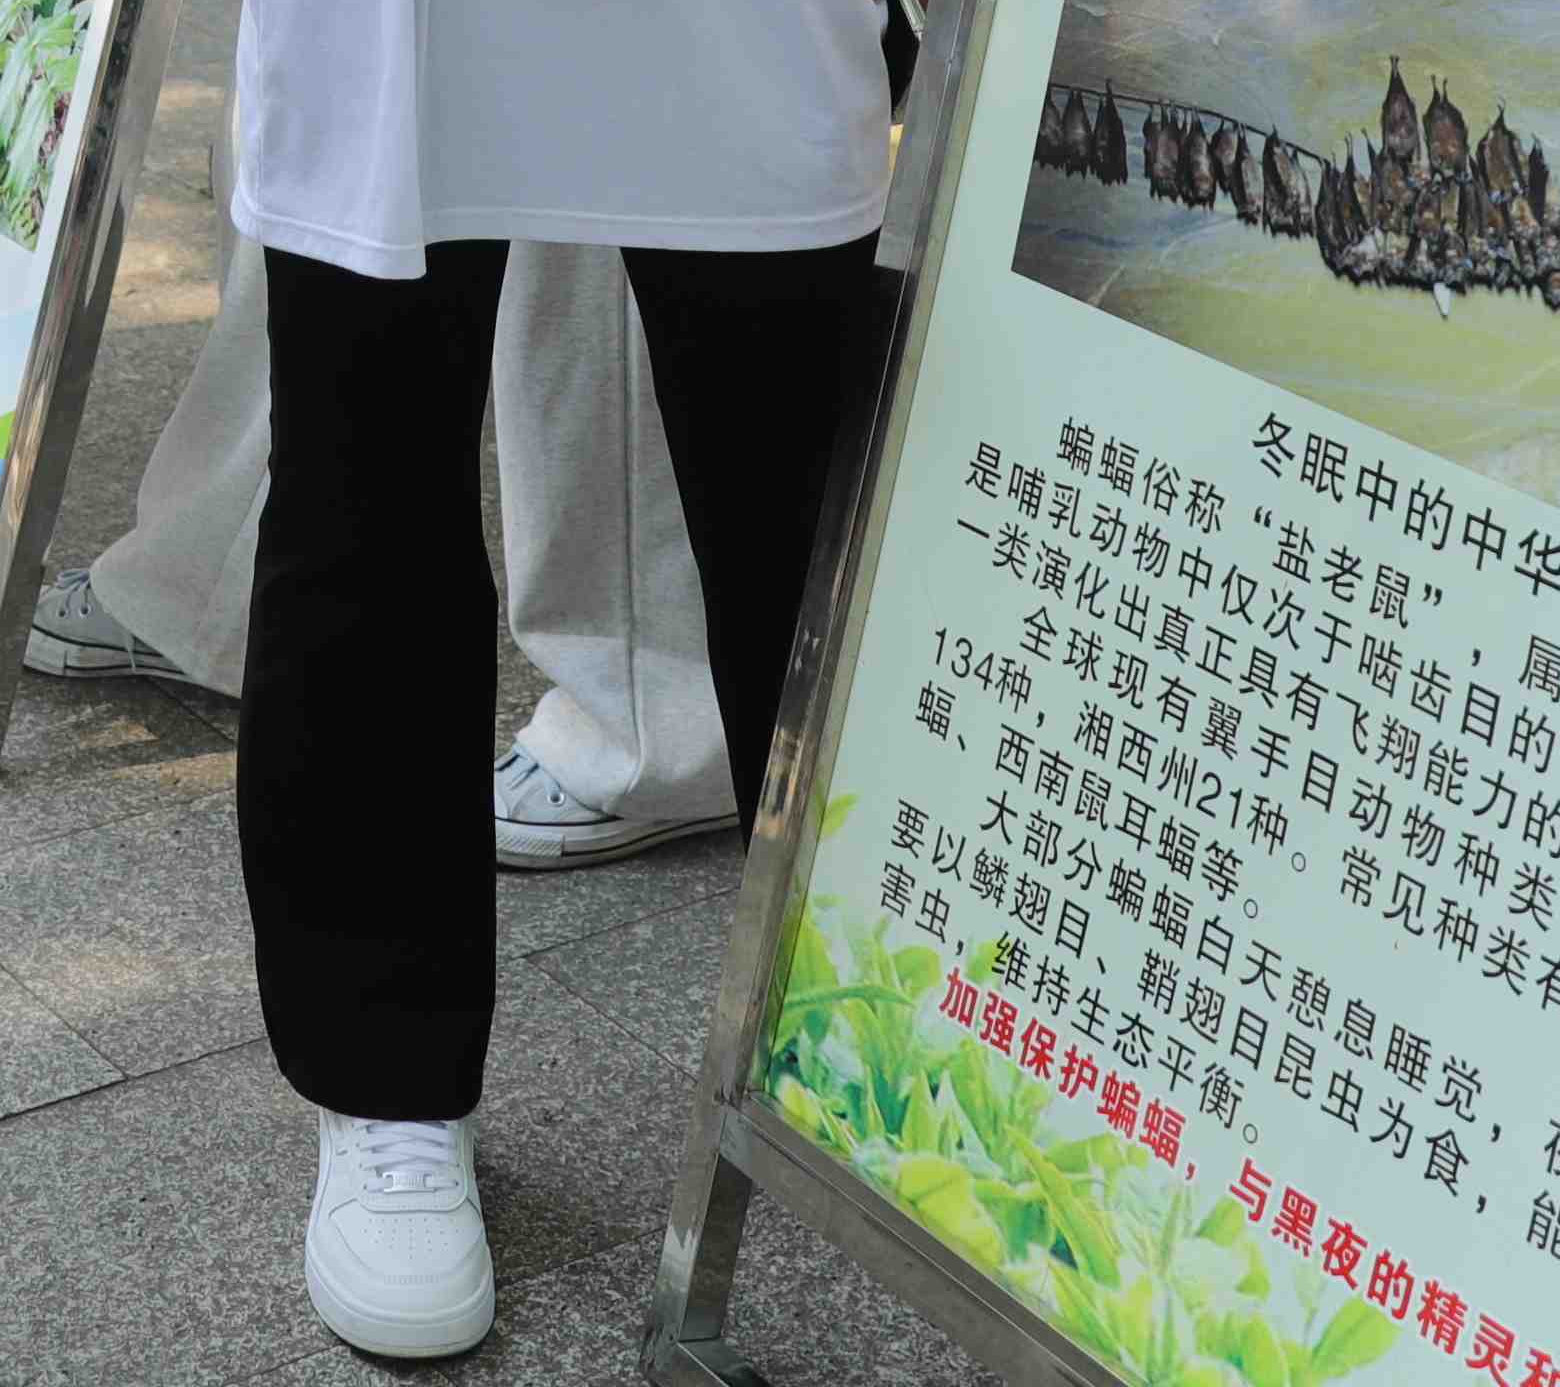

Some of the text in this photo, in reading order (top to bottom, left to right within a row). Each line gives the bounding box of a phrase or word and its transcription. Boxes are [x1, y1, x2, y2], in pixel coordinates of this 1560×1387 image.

[914, 679, 1259, 919] 蝠、西南鼠耳蝠等。
[880, 861, 1259, 1144] 害虫，维持生态平衡。
